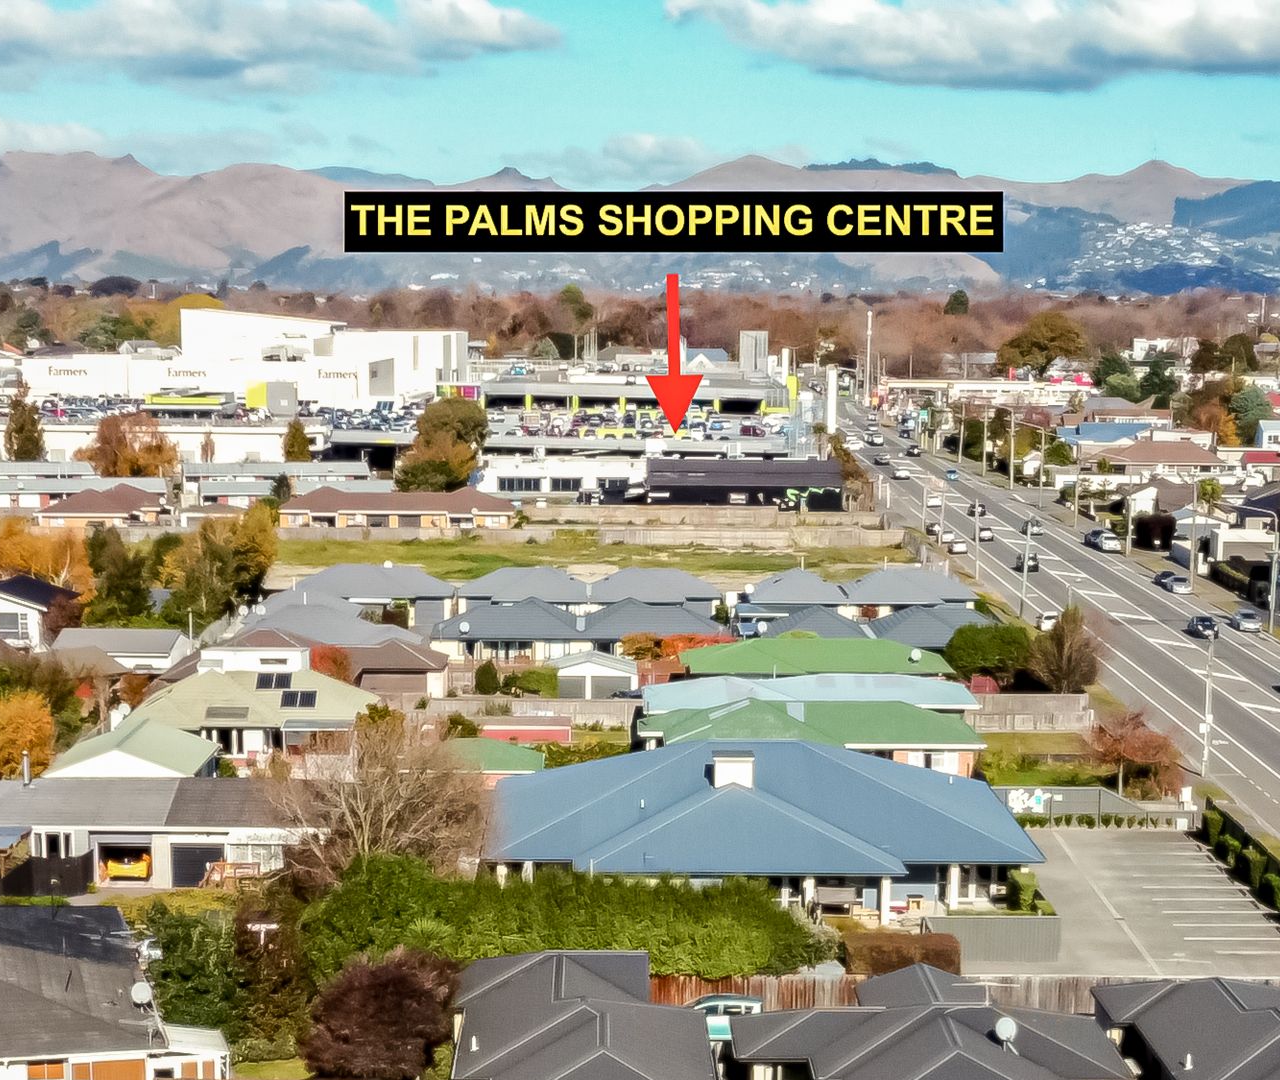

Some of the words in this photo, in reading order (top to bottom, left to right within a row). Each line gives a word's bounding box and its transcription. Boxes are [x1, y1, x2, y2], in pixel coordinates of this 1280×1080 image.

[47, 365, 88, 377] Farmers
[167, 367, 207, 378] Farmers
[317, 368, 358, 379] Farmers
